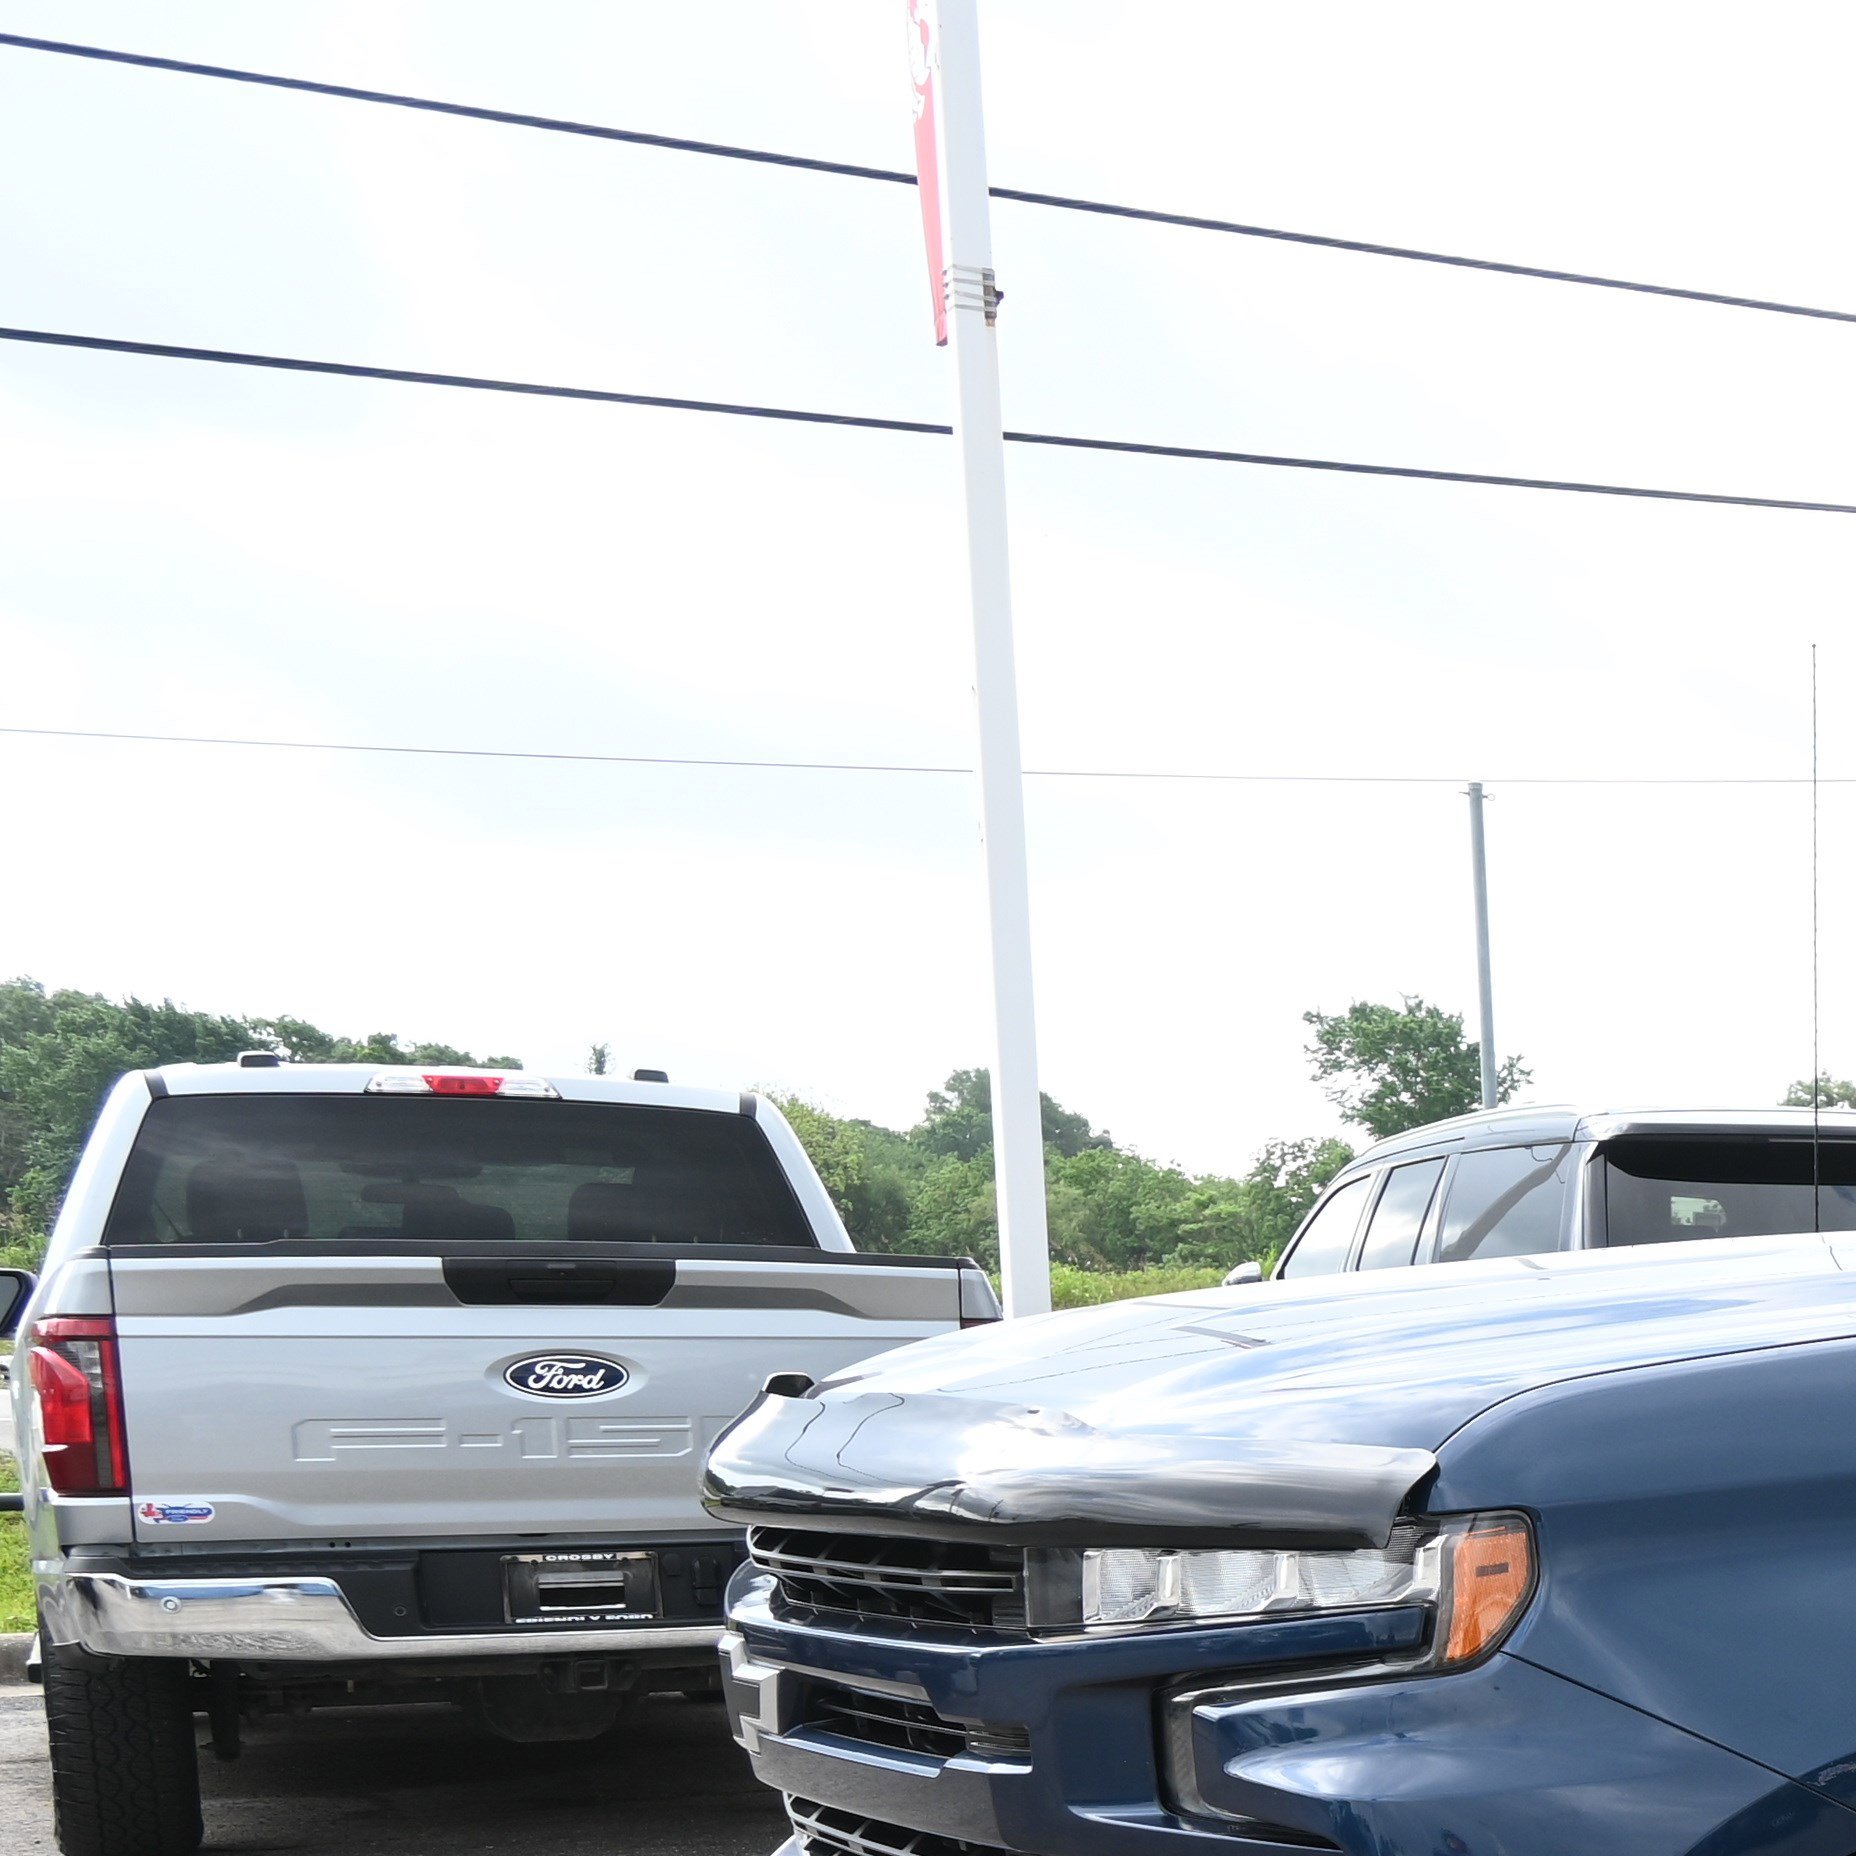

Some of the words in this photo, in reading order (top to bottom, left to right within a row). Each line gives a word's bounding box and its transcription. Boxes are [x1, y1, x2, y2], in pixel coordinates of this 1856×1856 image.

[527, 1361, 606, 1389] Ford
[292, 1414, 738, 1461] F-15
[545, 1553, 613, 1561] CROSBY
